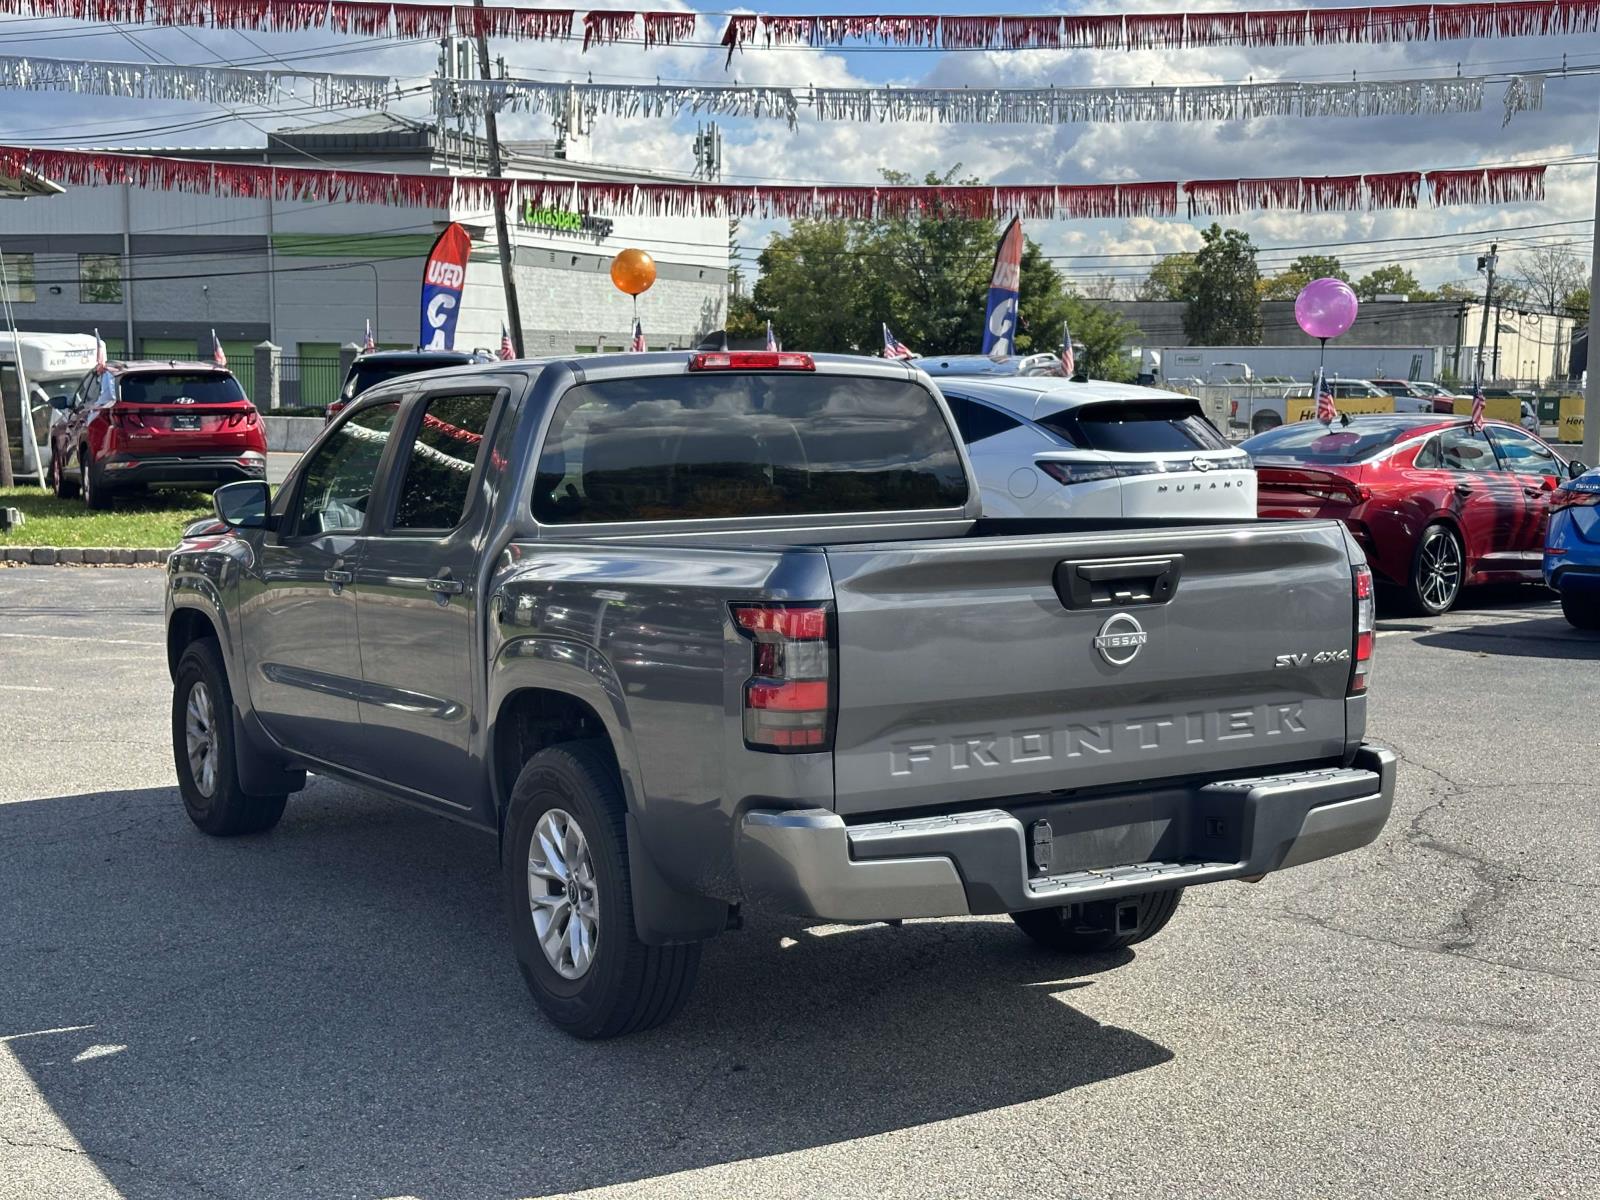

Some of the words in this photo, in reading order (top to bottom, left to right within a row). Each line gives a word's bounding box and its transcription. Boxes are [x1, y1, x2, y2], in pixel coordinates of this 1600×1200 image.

[428, 260, 463, 288] USED
[1158, 480, 1243, 493] MURANO
[1096, 635, 1147, 647] NISSAN
[1276, 653, 1307, 667] SV
[889, 700, 1307, 777] FRONTIER
